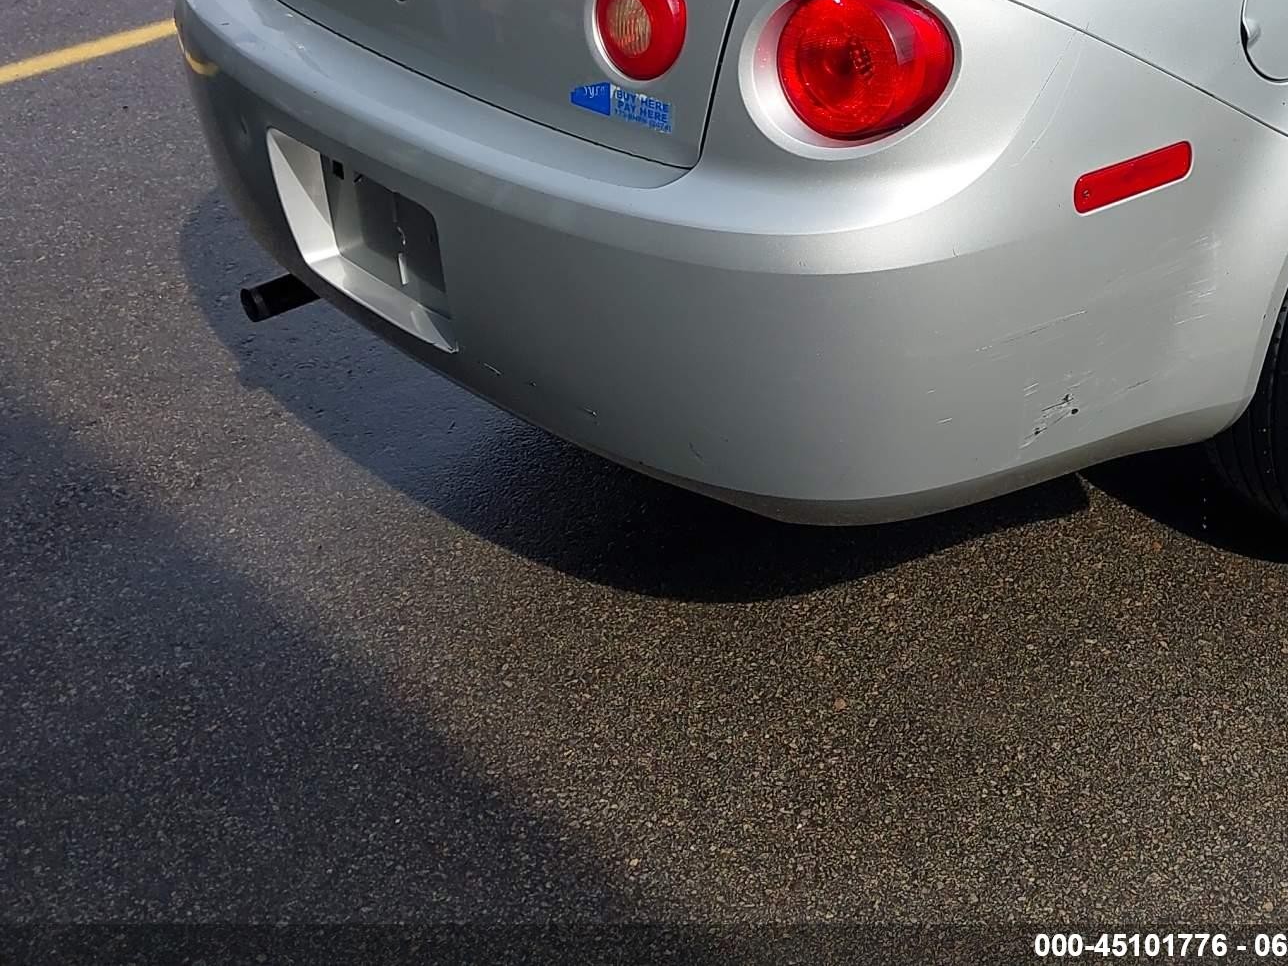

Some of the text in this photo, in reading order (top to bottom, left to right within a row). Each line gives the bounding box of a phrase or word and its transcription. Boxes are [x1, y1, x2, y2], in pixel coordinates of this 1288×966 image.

[616, 89, 637, 104] BUY
[640, 96, 669, 113] HERE
[616, 99, 637, 114] PAY
[639, 106, 668, 123] HERE
